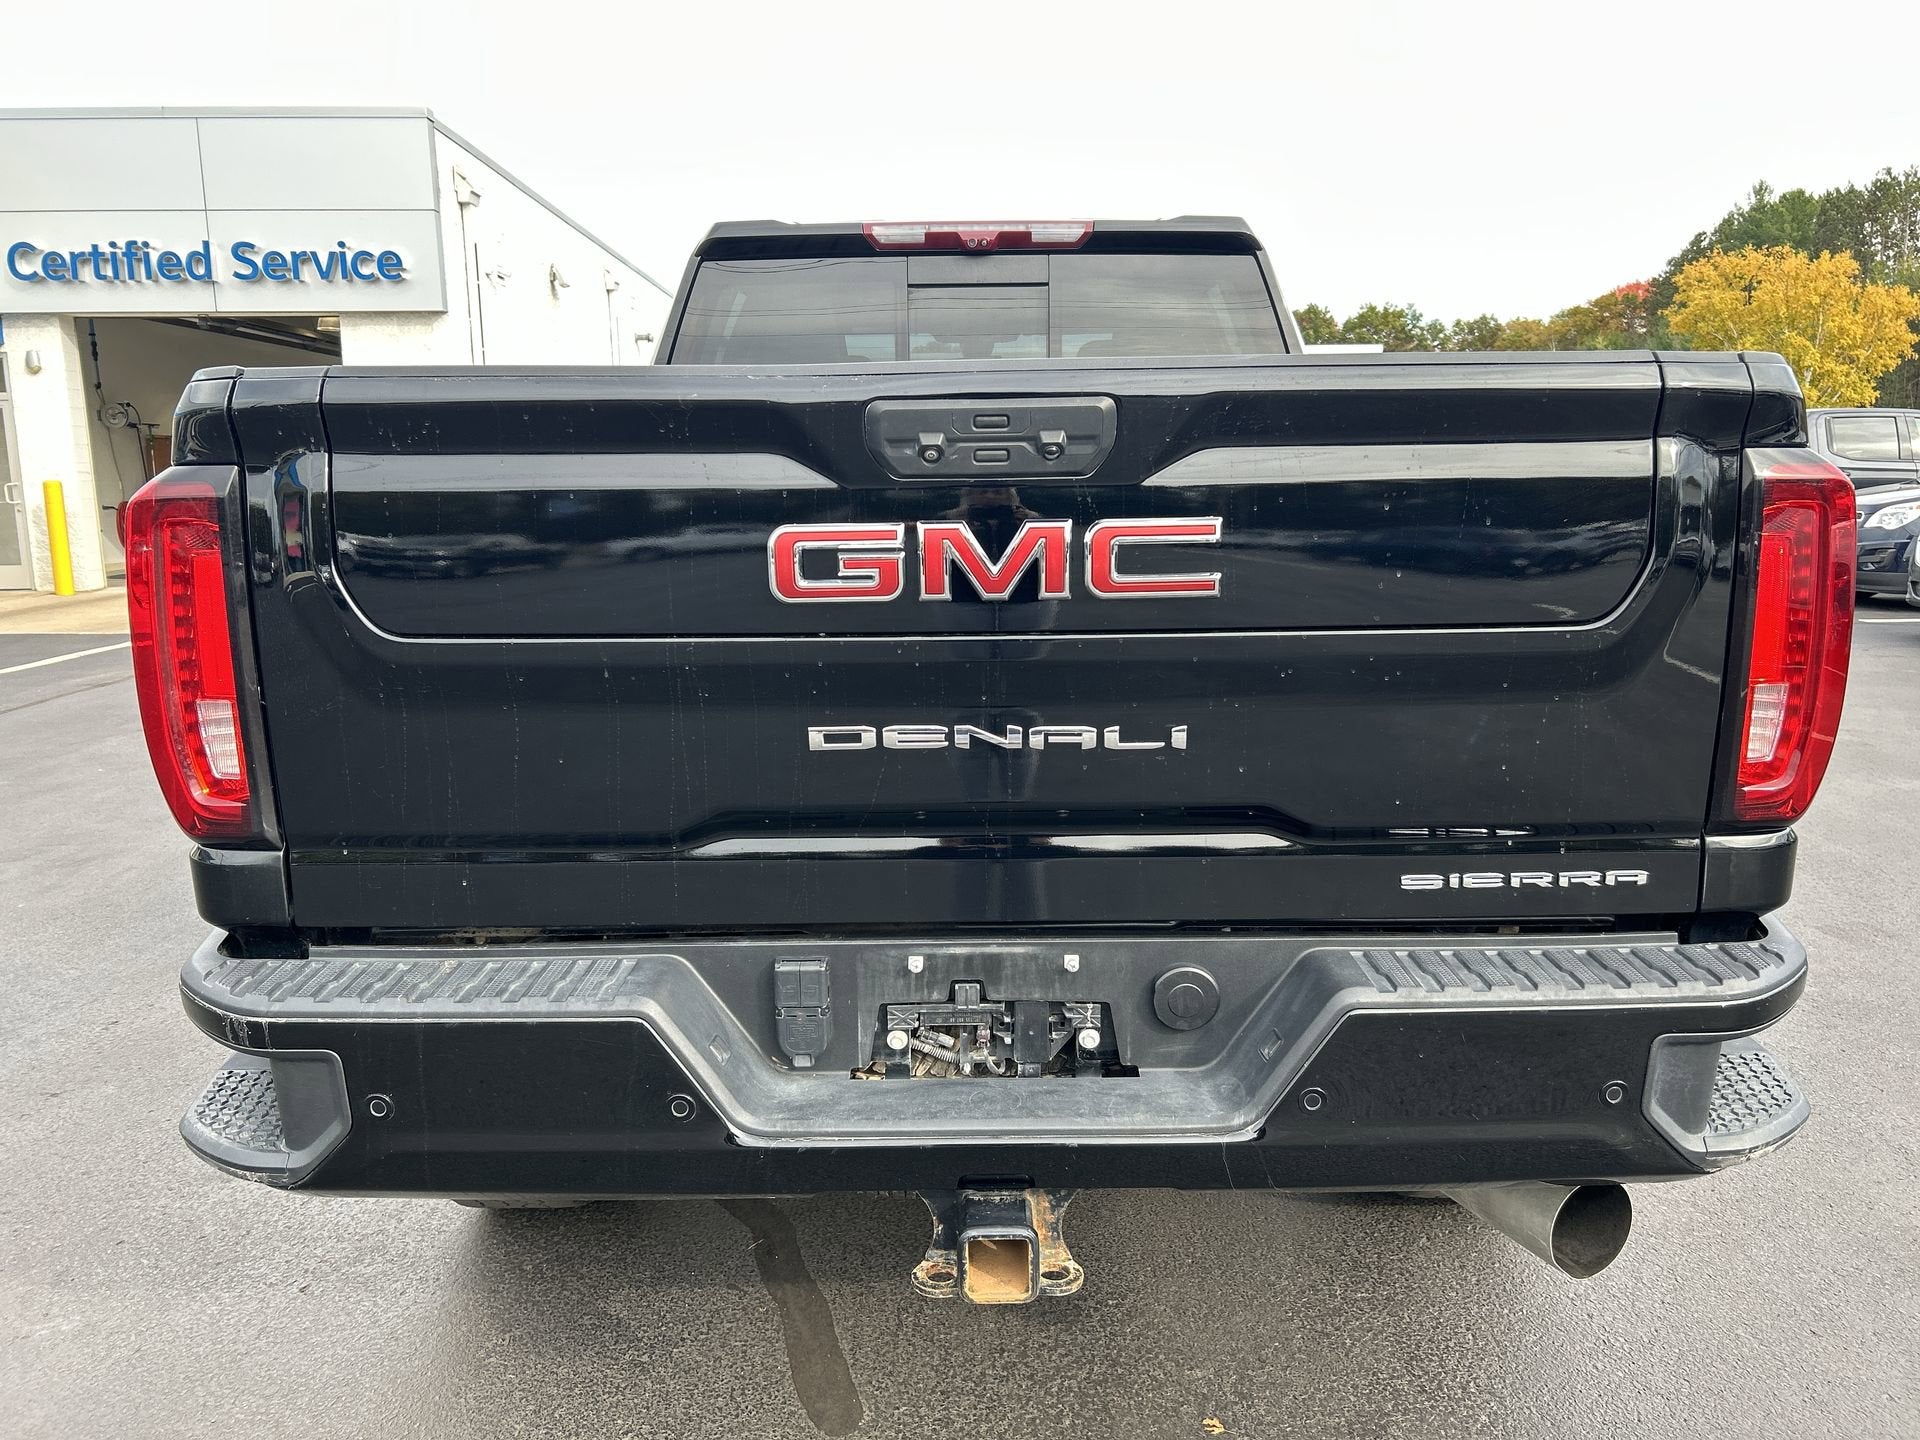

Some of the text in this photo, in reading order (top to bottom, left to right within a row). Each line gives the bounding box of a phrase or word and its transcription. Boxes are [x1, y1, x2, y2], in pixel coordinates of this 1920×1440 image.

[7, 240, 404, 282] Certified Service
[767, 516, 1223, 603] GMC
[807, 725, 1188, 751] DENALI
[1400, 869, 1650, 890] SIERRA
